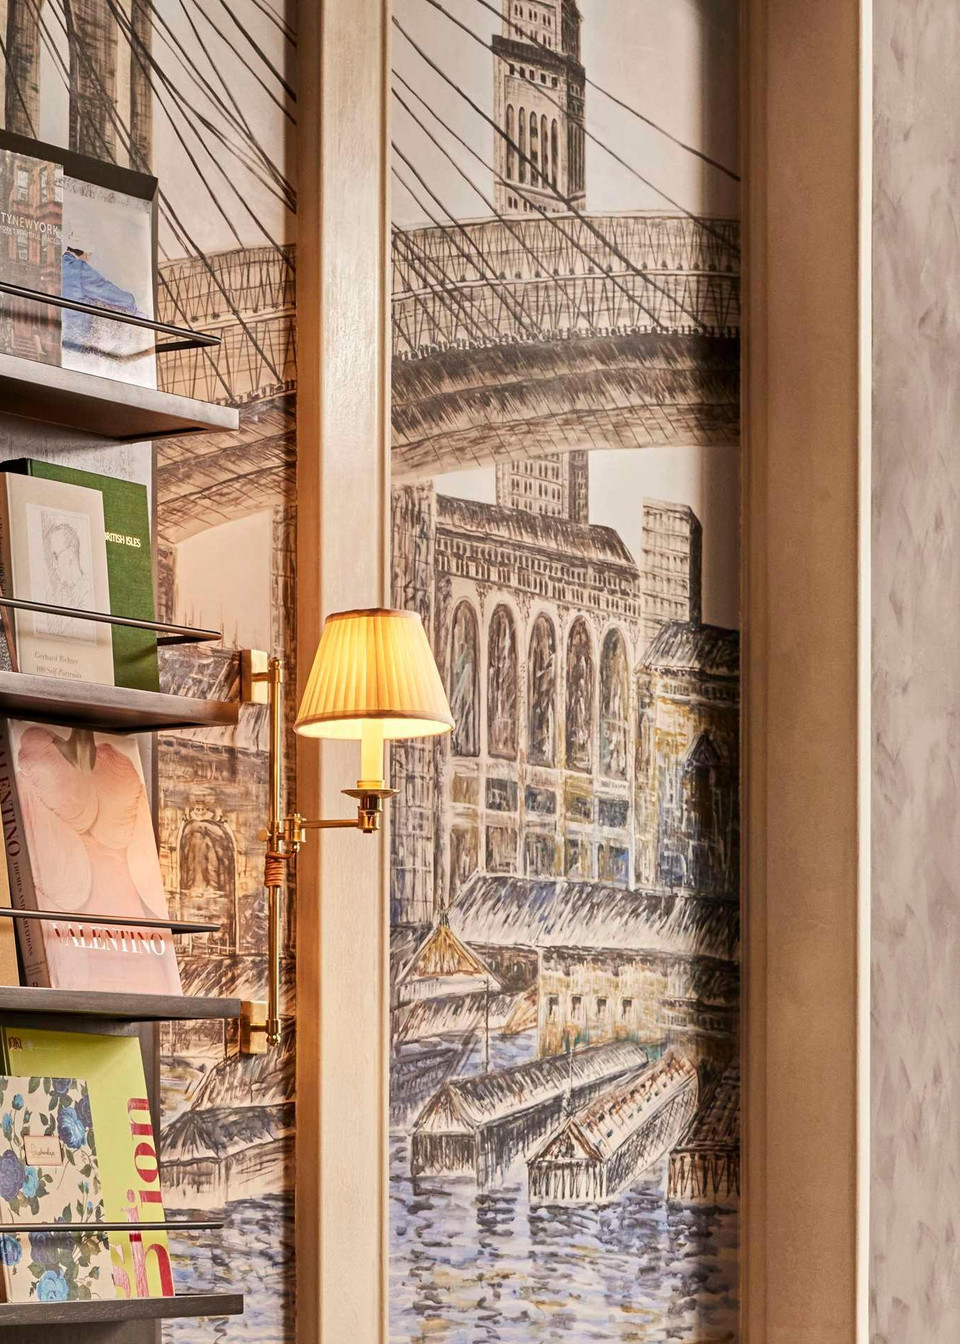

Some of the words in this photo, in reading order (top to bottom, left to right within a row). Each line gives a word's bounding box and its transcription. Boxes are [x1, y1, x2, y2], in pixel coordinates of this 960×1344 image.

[125, 535, 142, 548] ISLES
[13, 861, 23, 893] THEMES
[22, 911, 34, 957] ARIATIONS
[52, 923, 166, 957] VALENTINO
